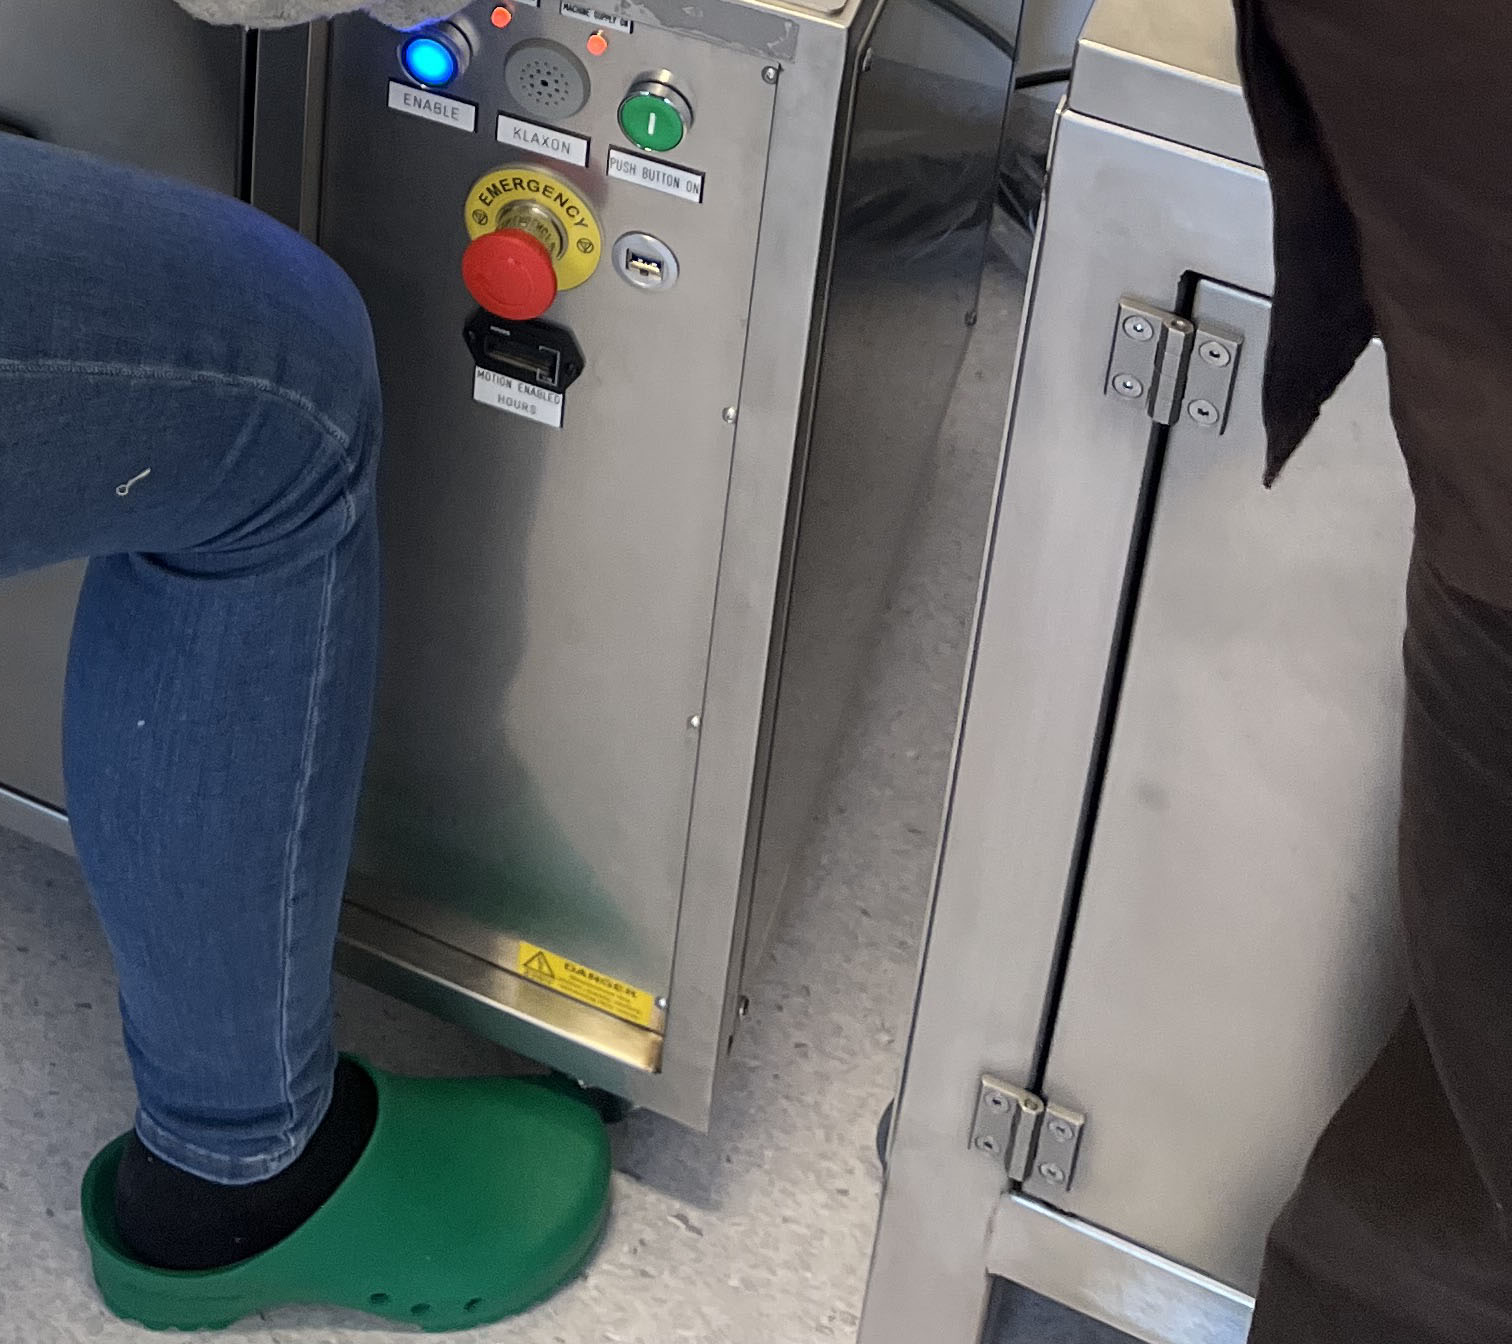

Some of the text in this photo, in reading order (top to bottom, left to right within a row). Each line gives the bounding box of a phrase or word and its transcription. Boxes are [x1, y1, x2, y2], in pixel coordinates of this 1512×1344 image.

[403, 92, 460, 120] ENABLE
[513, 126, 571, 156] KLAXON
[609, 157, 700, 194] PUSH BUTTON ON
[480, 177, 588, 229] EMERGENCY
[477, 368, 561, 405] MOTION ENABLED
[497, 393, 537, 415] HOURS
[564, 963, 638, 997] DANGER
